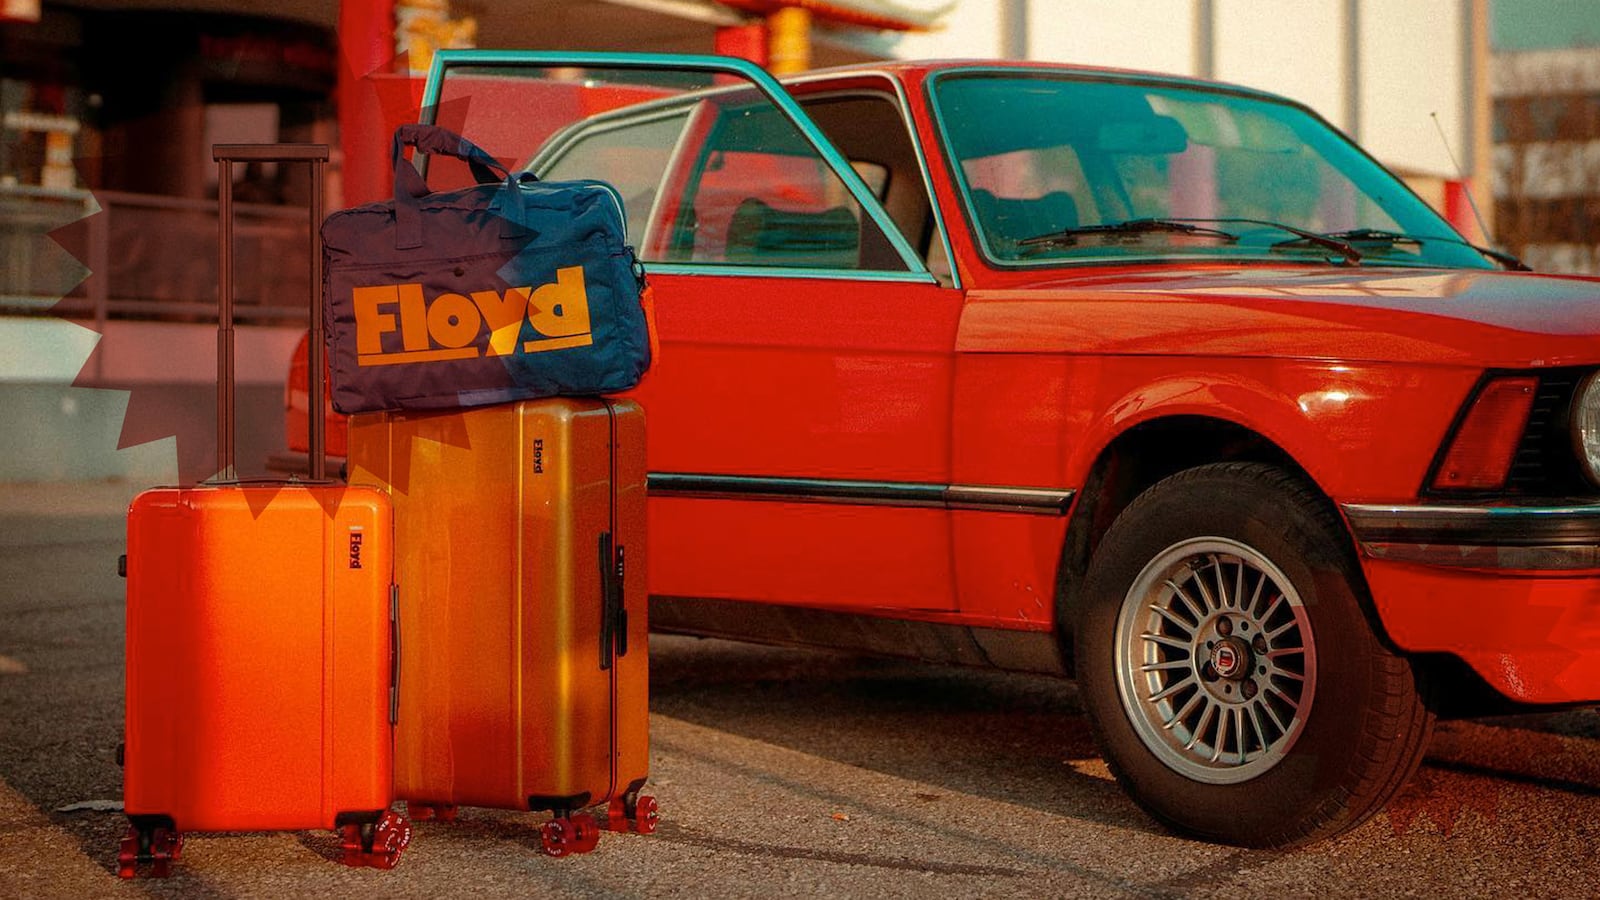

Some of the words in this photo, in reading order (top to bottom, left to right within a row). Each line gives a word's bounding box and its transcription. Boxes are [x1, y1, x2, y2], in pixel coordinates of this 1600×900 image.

[352, 265, 593, 367] Floyd
[533, 439, 543, 474] Floyd
[350, 533, 362, 569] Floyd
